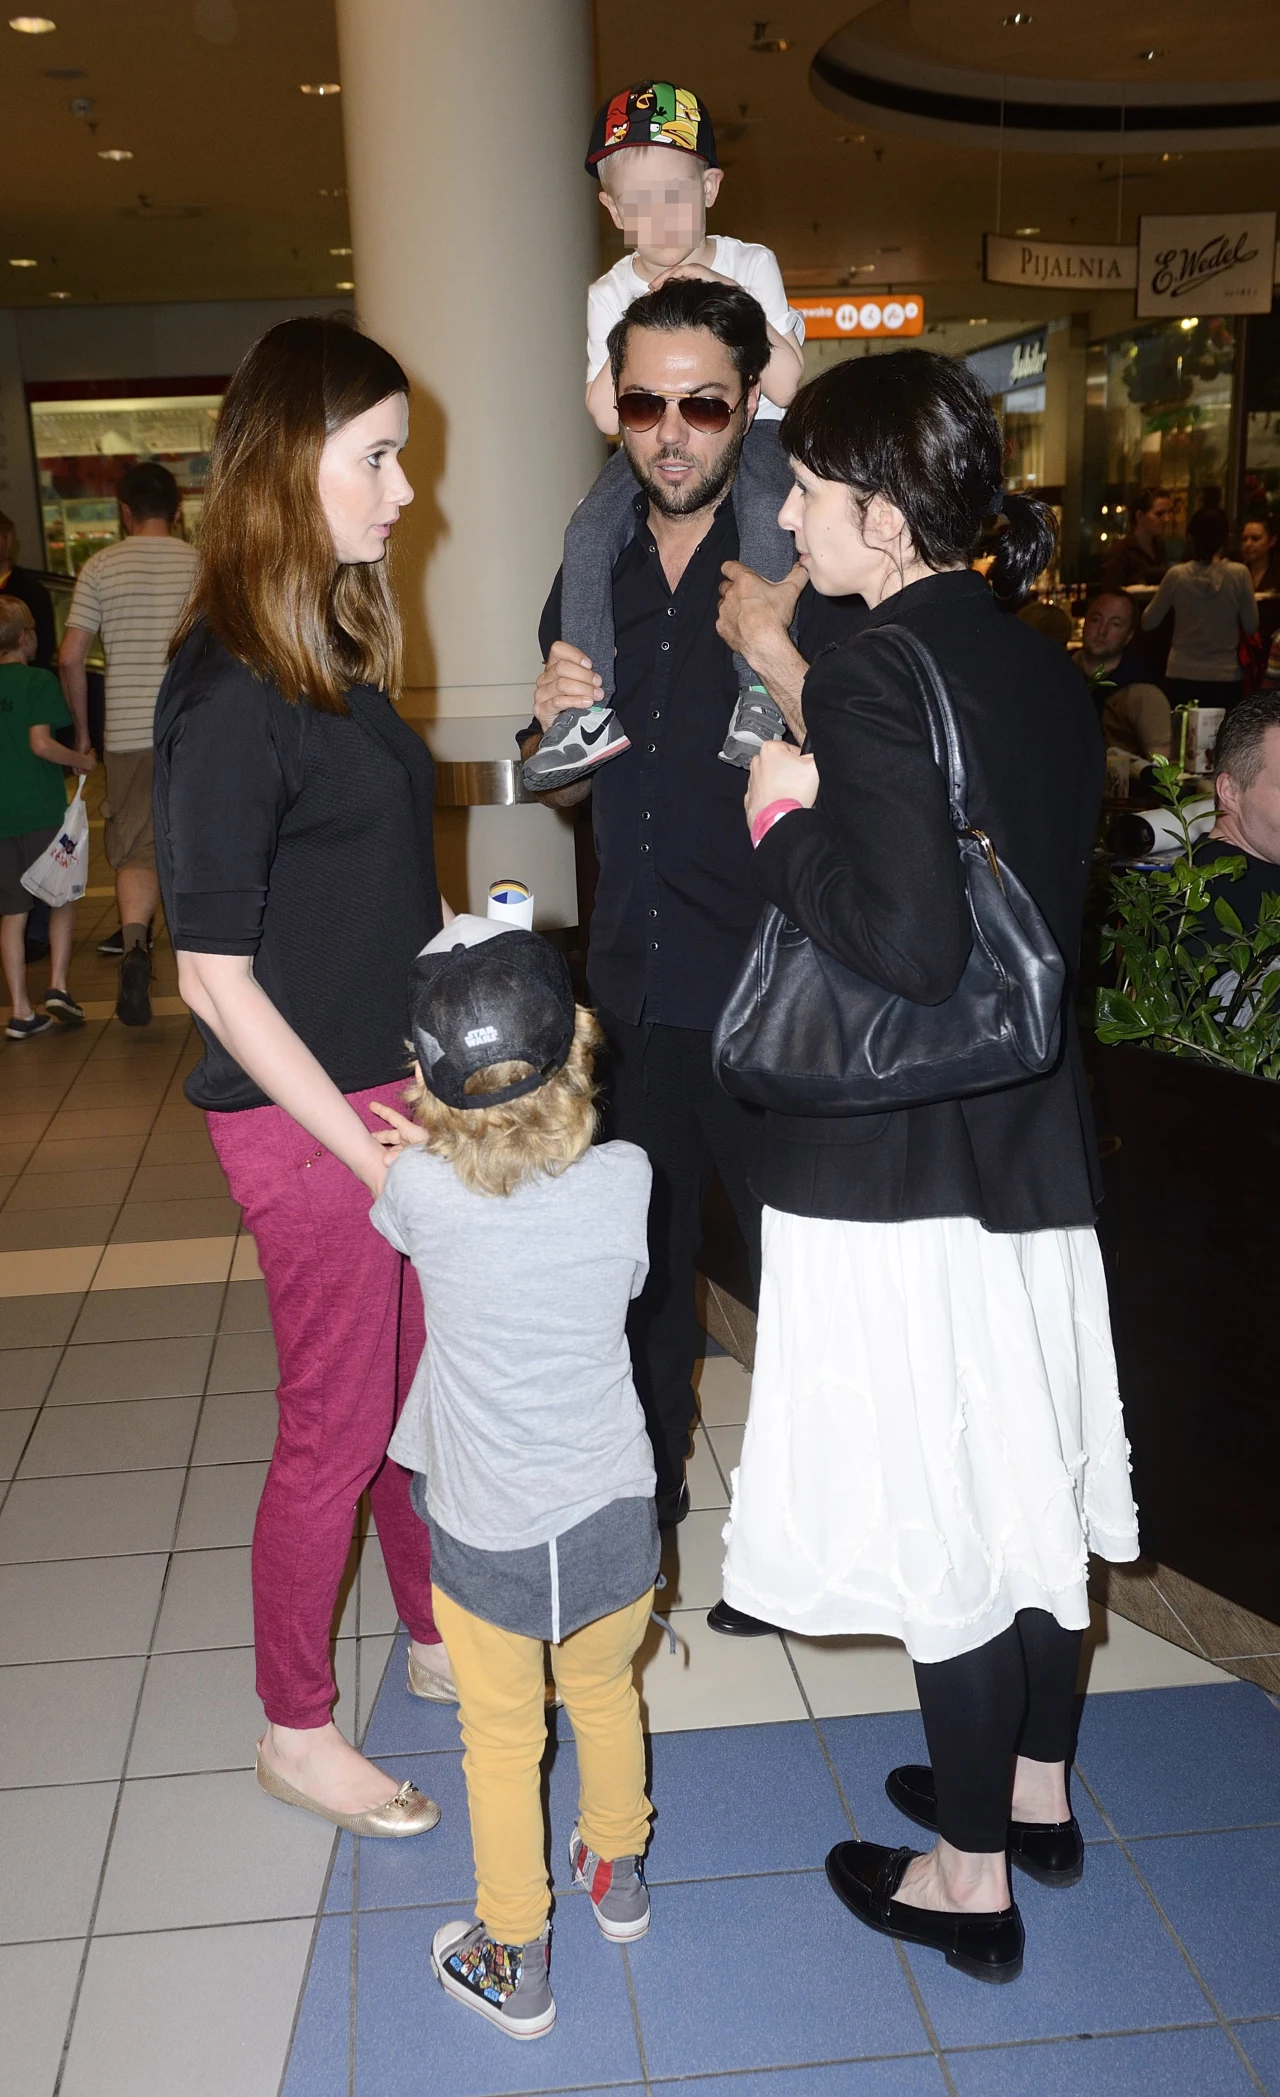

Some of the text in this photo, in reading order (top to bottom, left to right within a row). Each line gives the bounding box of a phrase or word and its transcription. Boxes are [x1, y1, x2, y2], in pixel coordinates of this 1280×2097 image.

[1021, 247, 1121, 281] PIJALNIA
[467, 1025, 498, 1037] STAR
[464, 1034, 498, 1048] WARS
